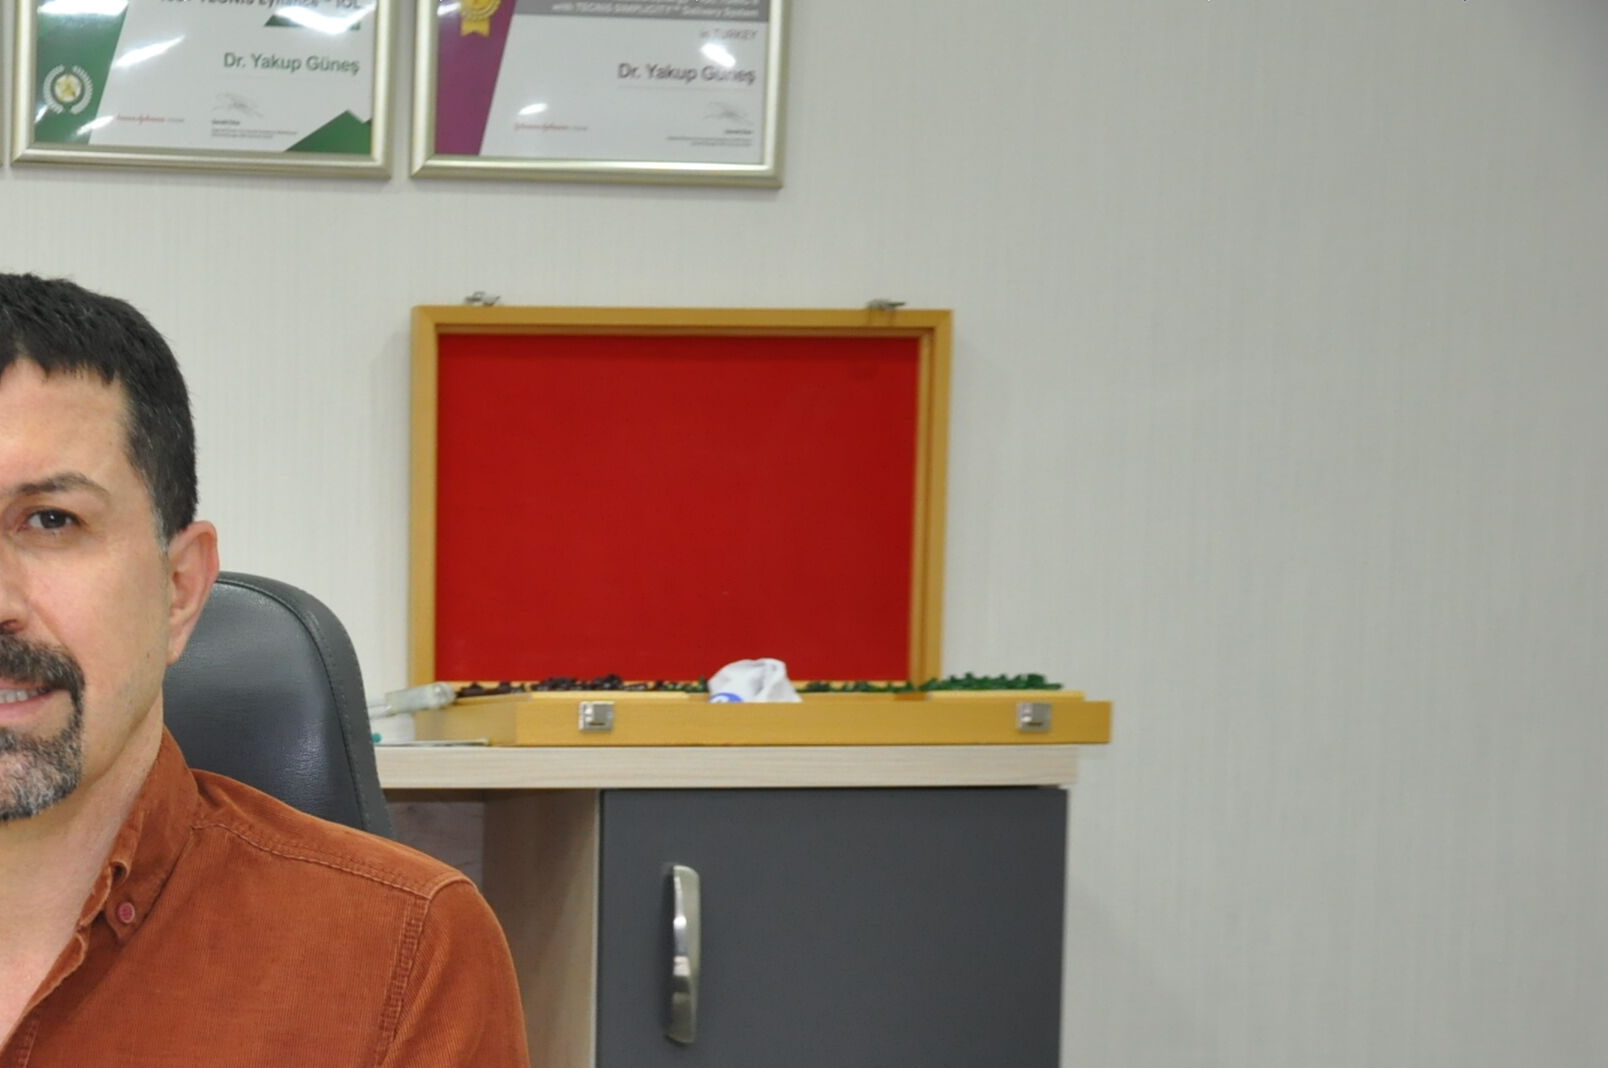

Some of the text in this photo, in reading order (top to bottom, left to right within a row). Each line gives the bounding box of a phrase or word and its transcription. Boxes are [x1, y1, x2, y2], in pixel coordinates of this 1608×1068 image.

[223, 52, 361, 75] Dr. Yakup Güneş
[617, 62, 641, 79] Dr.
[646, 63, 698, 83] Yakup
